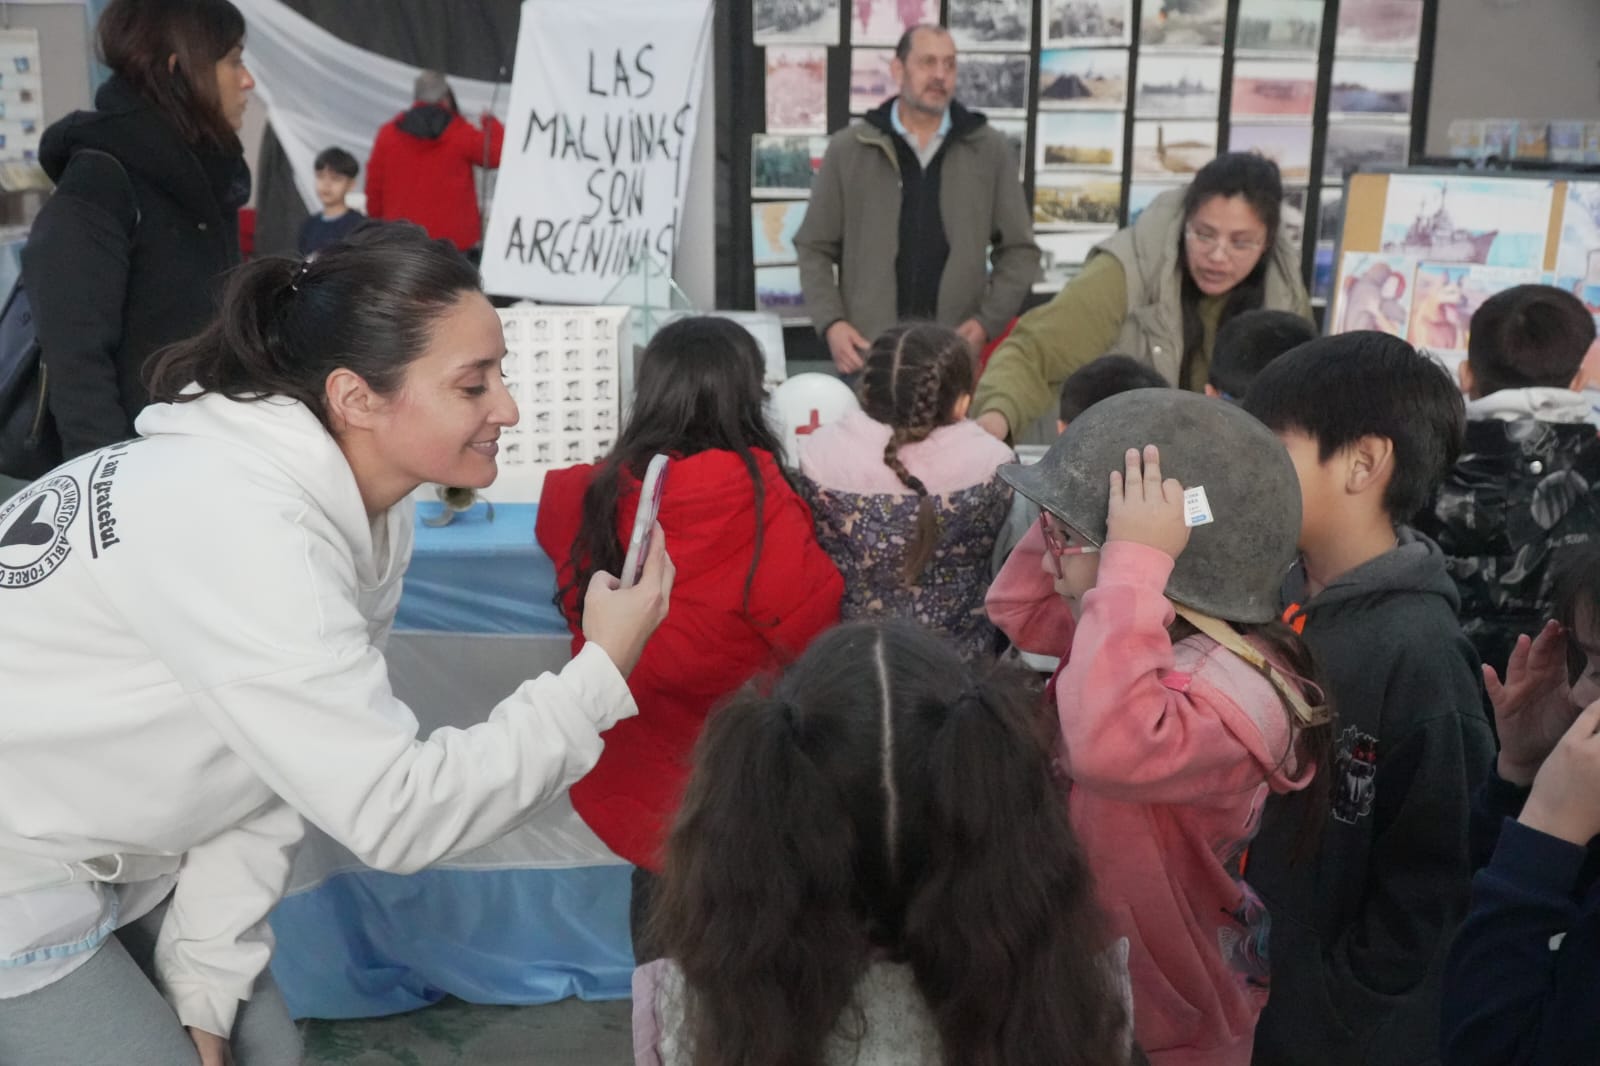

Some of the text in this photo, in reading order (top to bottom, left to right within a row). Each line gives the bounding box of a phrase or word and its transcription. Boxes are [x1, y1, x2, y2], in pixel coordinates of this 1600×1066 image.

[588, 43, 656, 99] LAS
[584, 169, 645, 223] SON
[505, 216, 674, 279] ARGENTINAS
[99, 460, 120, 479] am
[92, 480, 121, 550] grateful
[7, 564, 45, 585] FORCE
